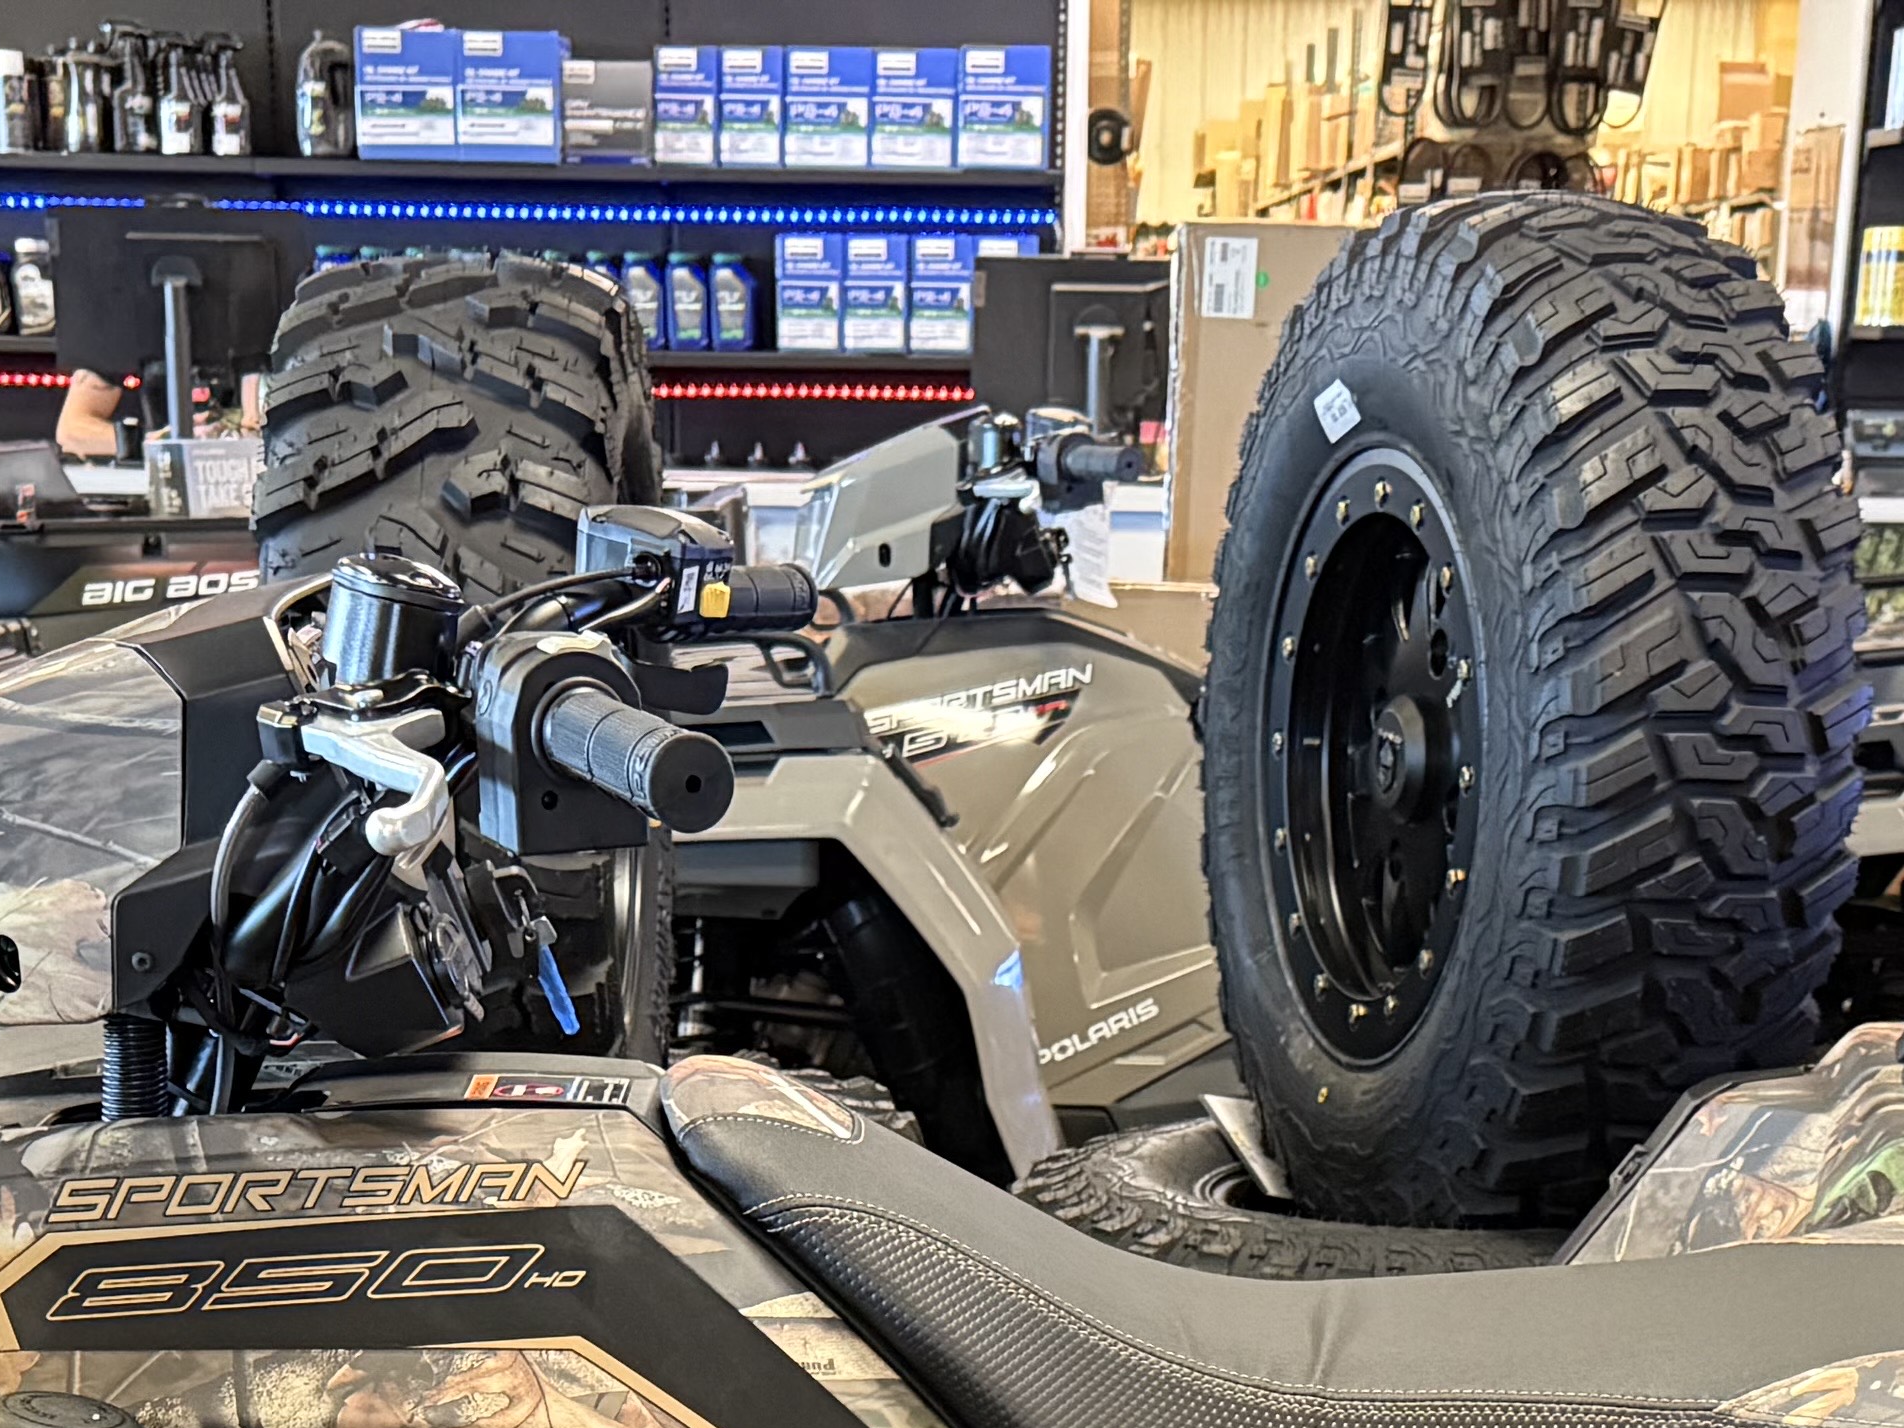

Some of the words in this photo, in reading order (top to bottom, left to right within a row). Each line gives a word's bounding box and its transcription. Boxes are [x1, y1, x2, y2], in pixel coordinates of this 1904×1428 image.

[166, 570, 260, 598] BOS
[1038, 998, 1159, 1065] POLARIS
[48, 1159, 588, 1223] SPORTSMAN
[45, 1244, 546, 1321] 850
[525, 1269, 587, 1290] HO
